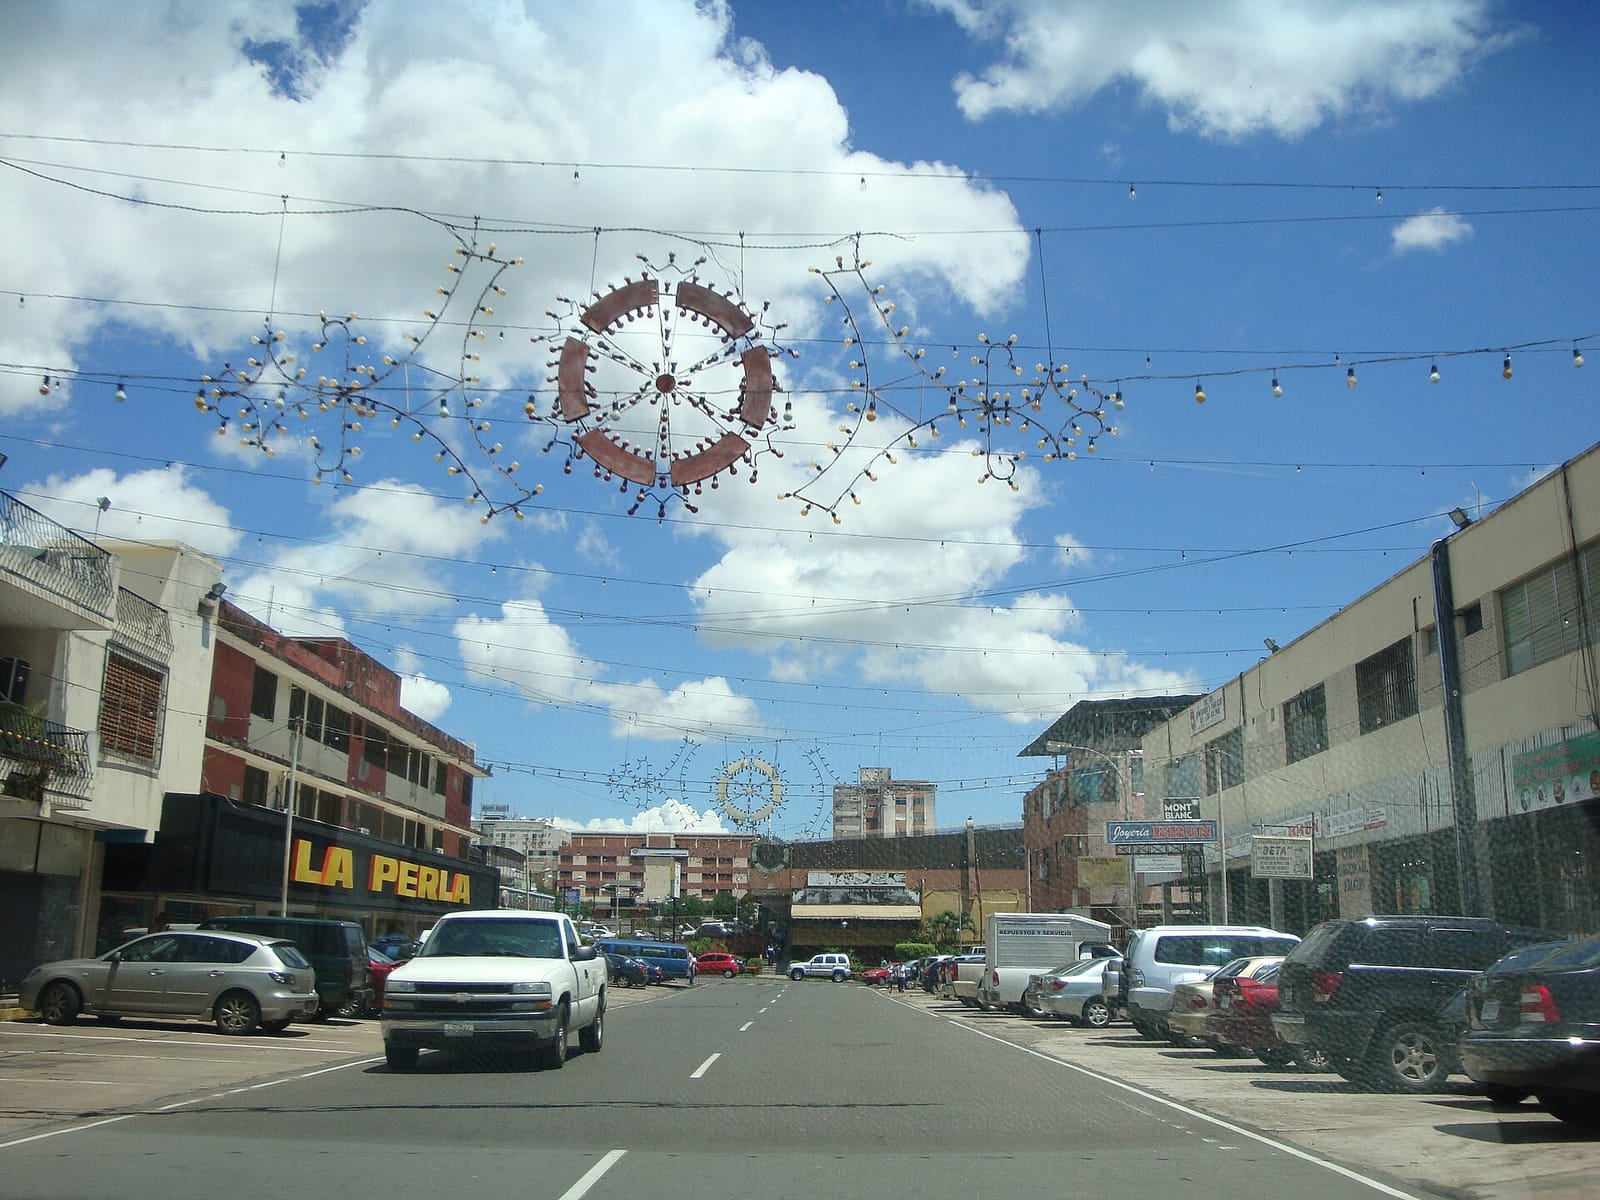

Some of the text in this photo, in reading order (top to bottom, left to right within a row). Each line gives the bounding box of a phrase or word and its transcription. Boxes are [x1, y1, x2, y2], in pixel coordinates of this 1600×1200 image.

[1164, 803, 1192, 811] MONT
[1165, 811, 1193, 819] BLANC
[1153, 825, 1212, 839] BRUN
[290, 838, 470, 904] LA PERLA
